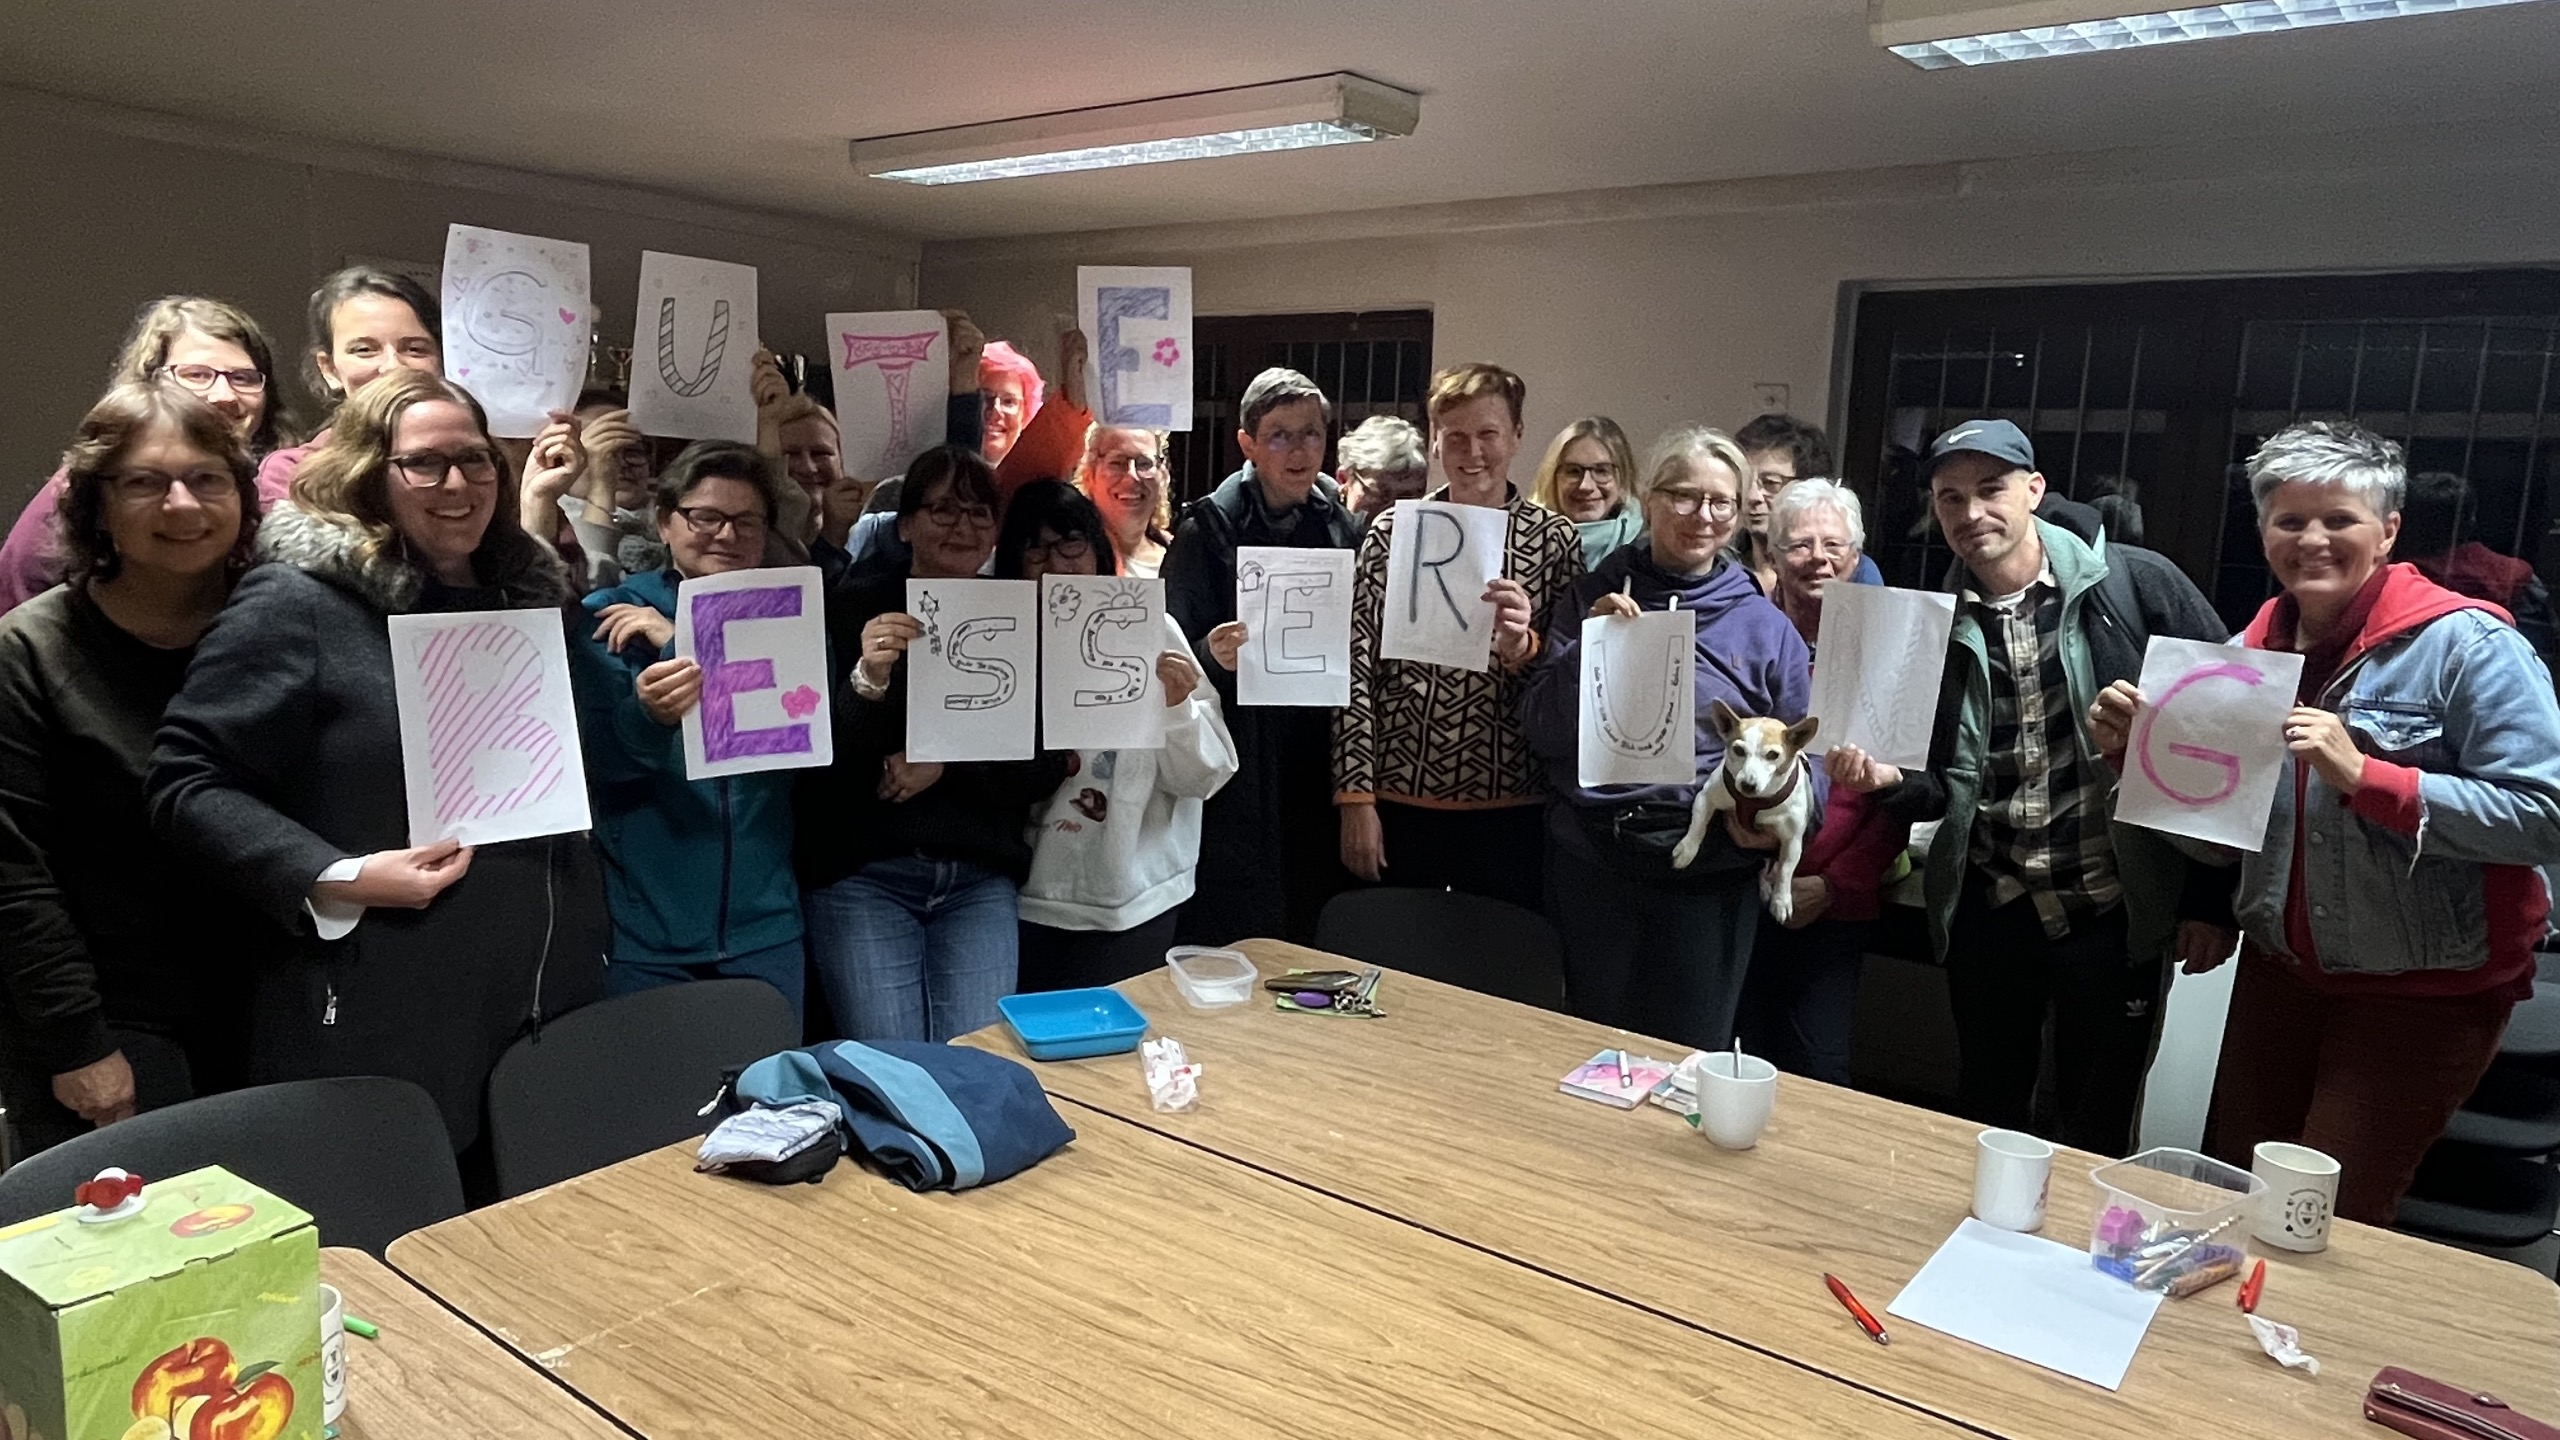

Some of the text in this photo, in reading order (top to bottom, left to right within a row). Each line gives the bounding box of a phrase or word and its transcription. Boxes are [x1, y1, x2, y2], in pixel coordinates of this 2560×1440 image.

[659, 297, 729, 397] U
[842, 331, 939, 472] T
[1097, 286, 1172, 425] E
[1263, 572, 1332, 674] E
[1409, 509, 1468, 632] R
[691, 585, 812, 763] E
[944, 616, 1017, 711] S
[1074, 606, 1148, 707] S
[1589, 634, 1684, 760] U
[411, 622, 564, 824] B
[2137, 662, 2265, 810] G
